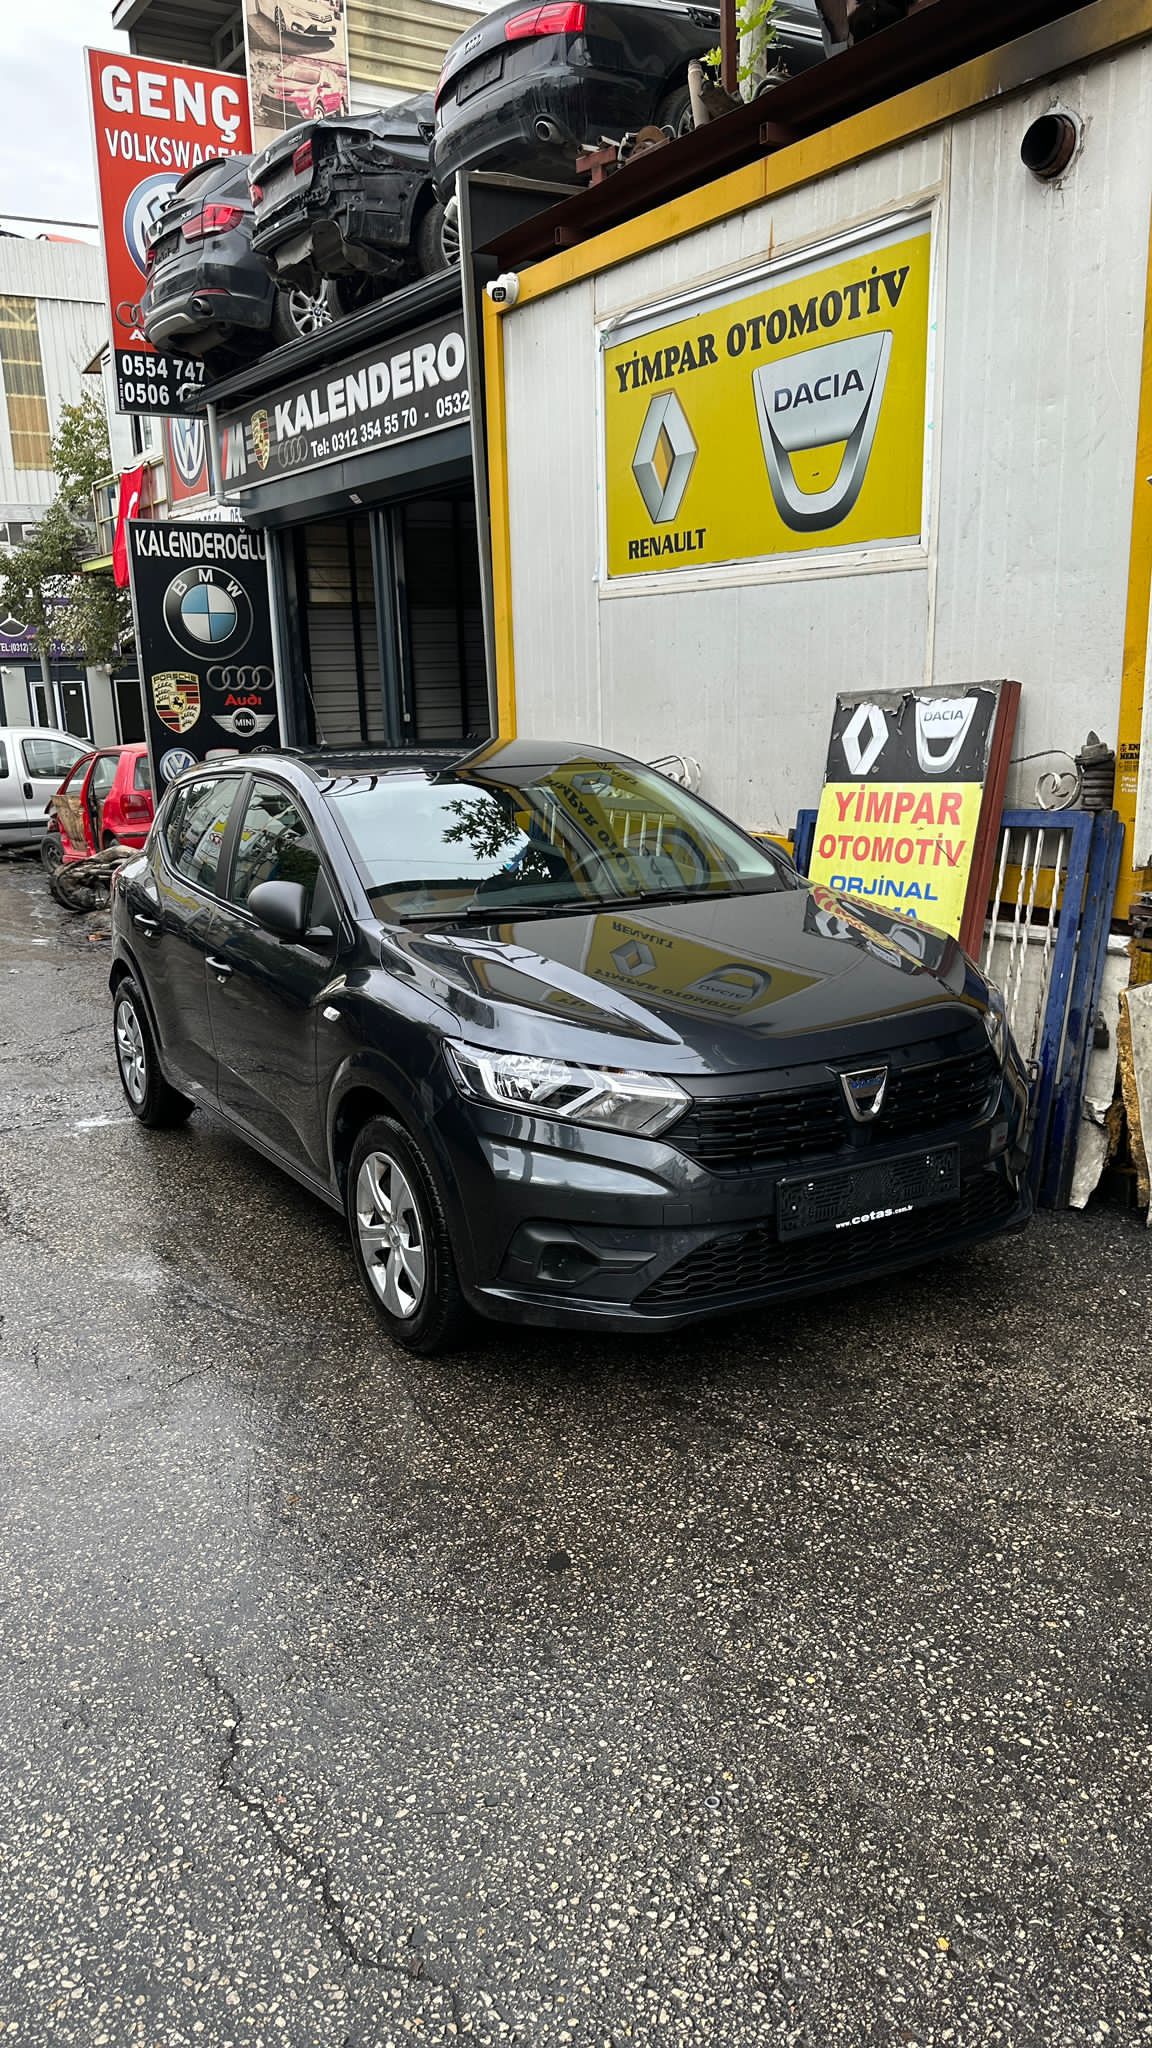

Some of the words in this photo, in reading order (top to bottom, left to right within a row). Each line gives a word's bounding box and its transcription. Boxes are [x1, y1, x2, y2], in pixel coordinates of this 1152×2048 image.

[101, 65, 241, 143] GENÇ
[615, 332, 718, 393] YİMPAR
[726, 265, 911, 358] OTOMOTİV
[121, 354, 168, 379] 0554
[172, 359, 205, 382] 747
[124, 381, 170, 406] 0506
[774, 368, 865, 413] DACIA
[310, 437, 330, 459] Tel:
[331, 427, 359, 452] 0312
[360, 418, 382, 443] 354
[384, 413, 399, 435] 55
[401, 407, 418, 429] 70
[436, 389, 470, 419] 0532
[135, 527, 267, 561] KALENDEROĞLU
[628, 528, 706, 560] RENAULT
[153, 672, 198, 682] PORSCHE
[224, 693, 262, 706] Audi
[233, 718, 255, 728] MINI
[923, 709, 965, 723] DACIA
[835, 783, 963, 826] YİMPAR
[819, 832, 967, 868] OTOMOTİV
[829, 874, 938, 901] ORJİNAL
